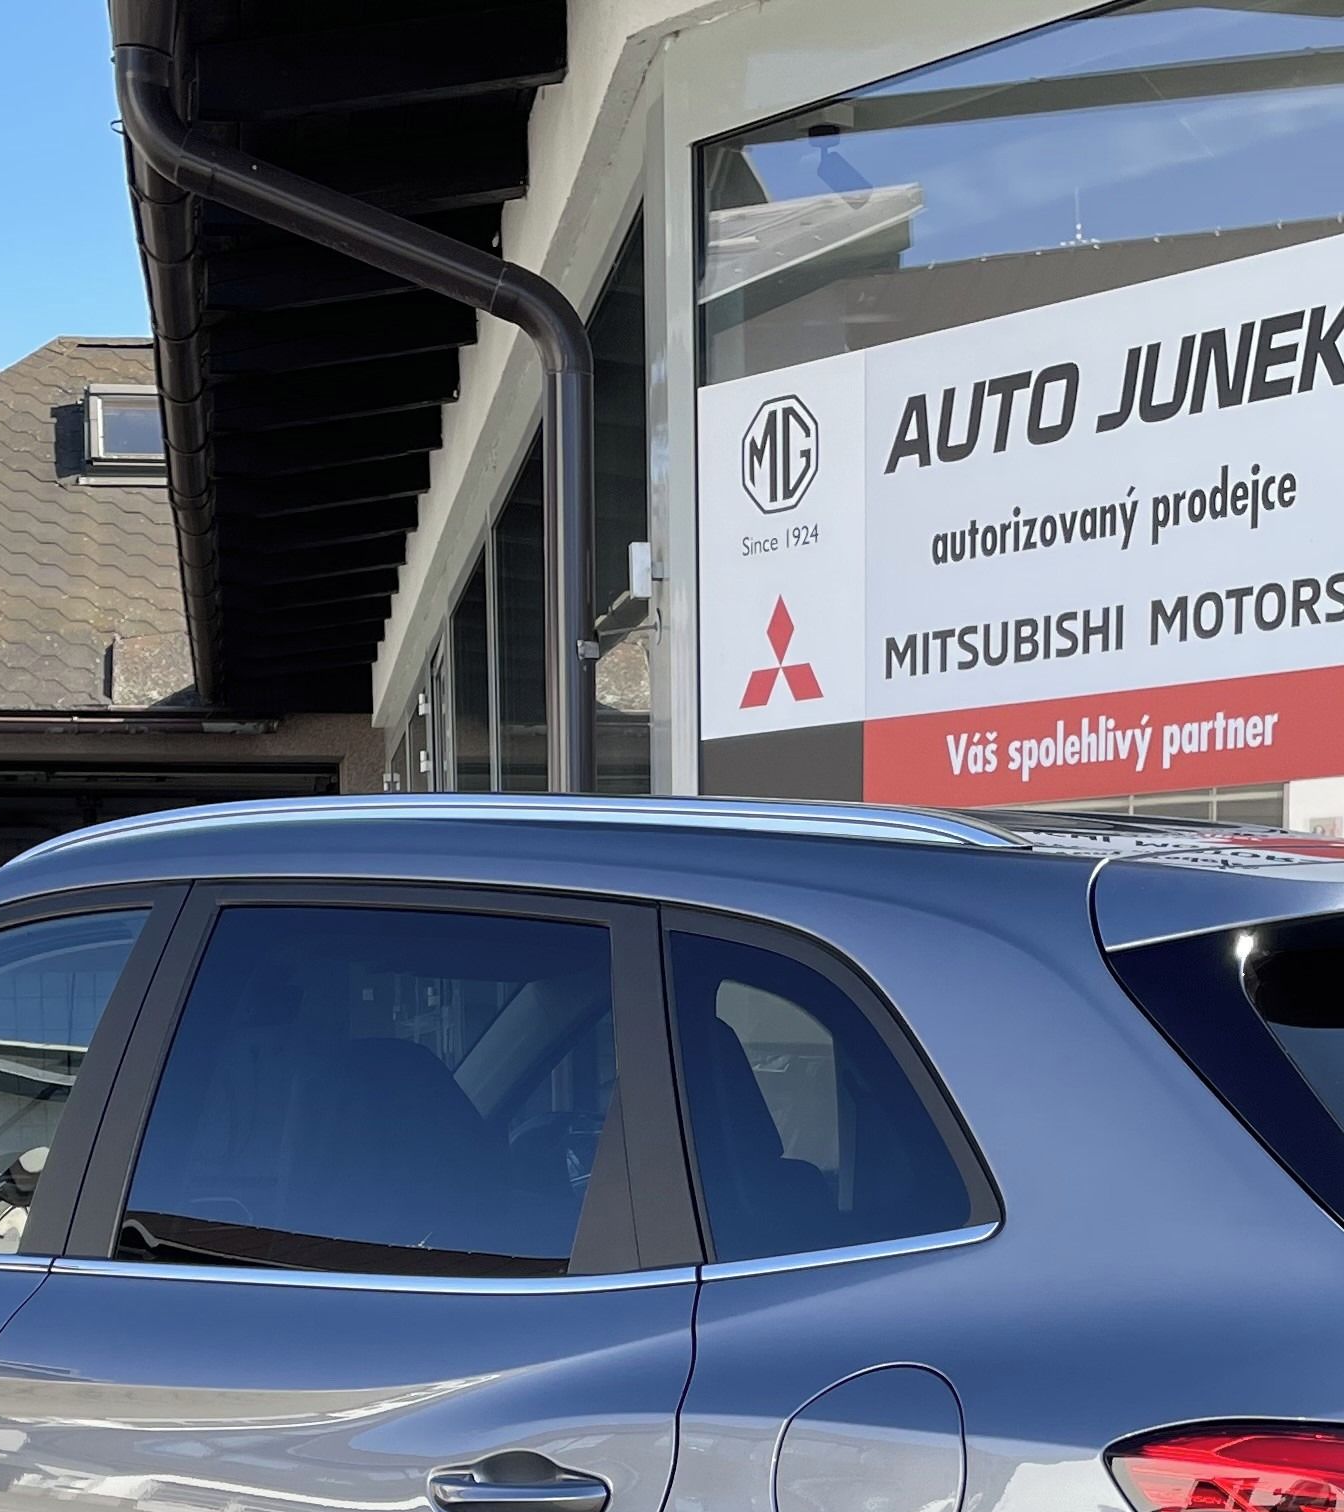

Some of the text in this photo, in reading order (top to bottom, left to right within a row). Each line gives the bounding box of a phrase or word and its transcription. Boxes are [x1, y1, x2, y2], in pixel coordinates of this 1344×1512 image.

[747, 402, 815, 507] MG
[884, 362, 1079, 474] AUTO
[742, 523, 819, 556] Since 1924
[932, 464, 1296, 564] autorizovaný prodejce
[885, 605, 1124, 680] MITSUBISHI
[946, 711, 1279, 782] Váš spolehlivý partner
